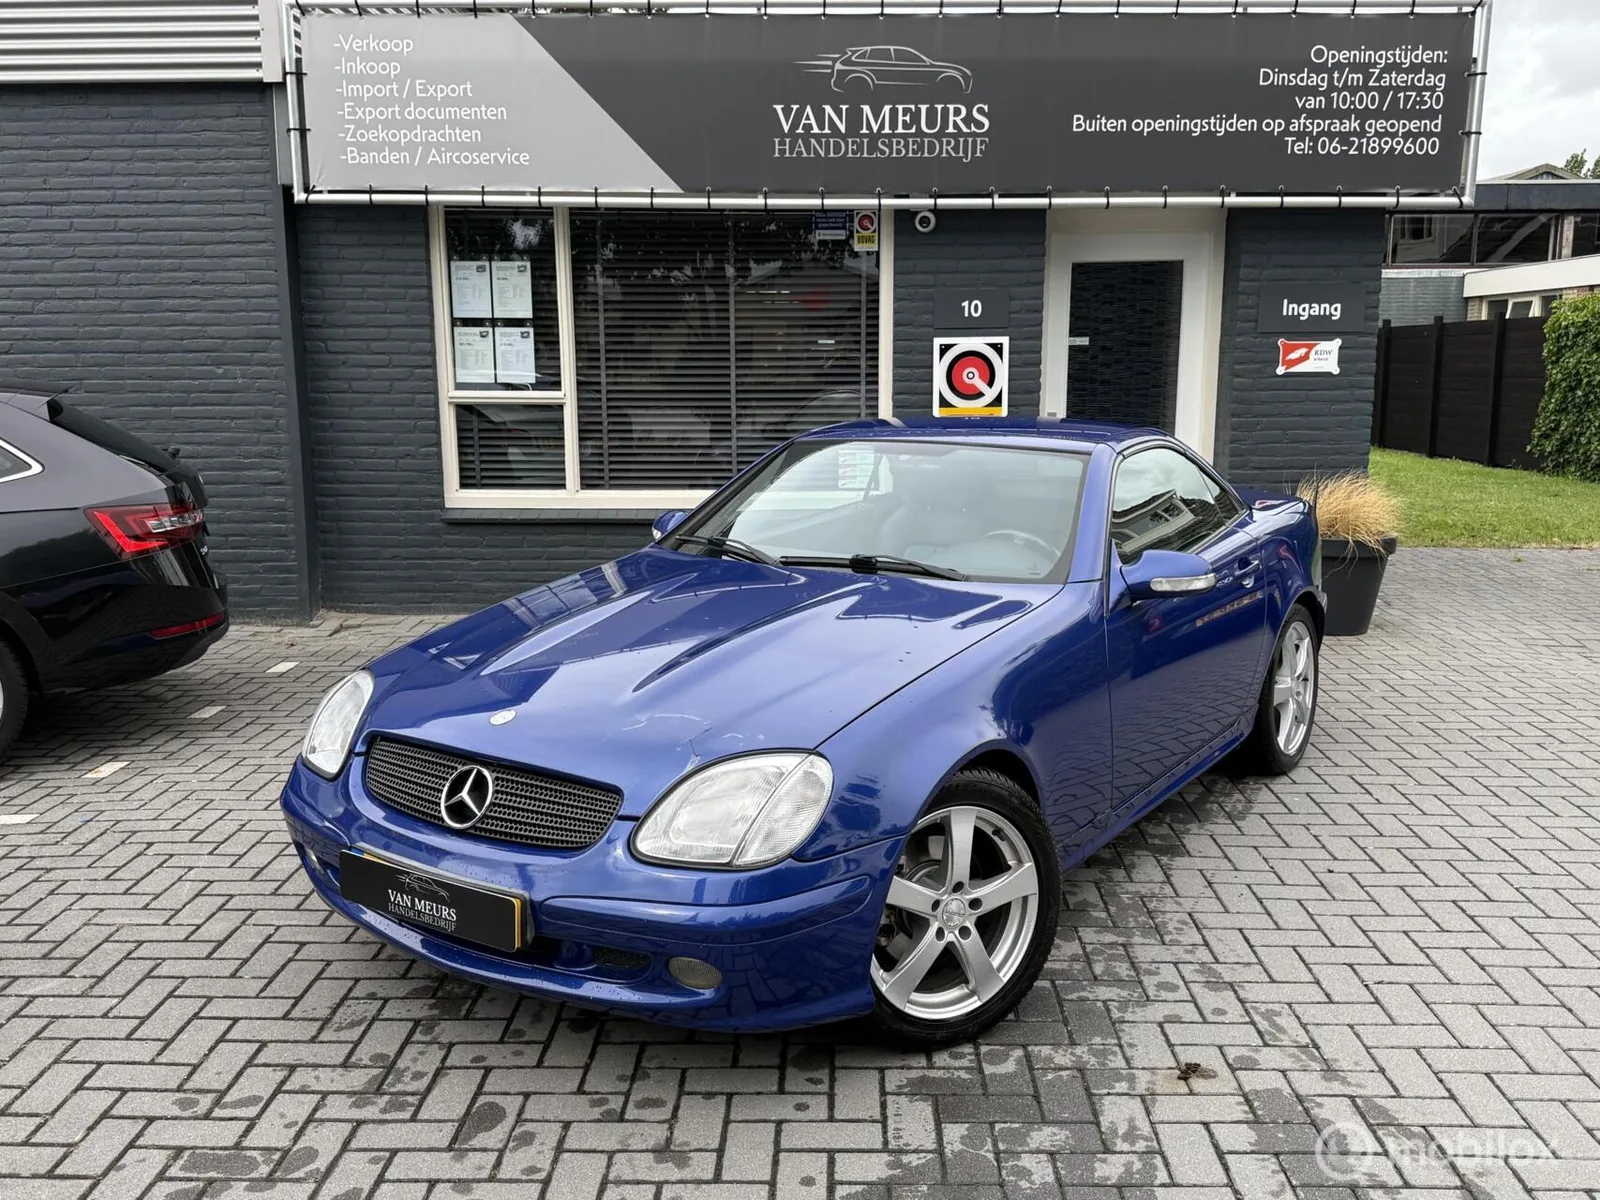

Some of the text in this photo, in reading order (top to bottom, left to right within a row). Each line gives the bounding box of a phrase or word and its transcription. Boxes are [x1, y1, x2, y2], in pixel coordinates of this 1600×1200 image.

[333, 33, 414, 56] -Verkoop
[1310, 44, 1448, 67] Openingstijden:
[334, 56, 401, 79] -Inkoop
[1258, 67, 1447, 91] Dinsdag t/m Zaterdag
[335, 79, 473, 102] -Import / Export
[1295, 91, 1444, 111] van 10:00 / 17:30
[337, 102, 507, 124] -Export documenten
[772, 103, 991, 134] VAN MEURS
[338, 124, 482, 147] -Zoekopdrachten
[1072, 114, 1443, 137] Buiten openingstijden op afspraak geopend
[340, 146, 530, 166] -Banden / Aircoservice
[772, 137, 990, 163] HANDELSBEDRIJF
[1284, 137, 1440, 155] Tel: 06-21899600
[961, 299, 983, 318] 10
[1282, 298, 1342, 321] Ingang
[388, 889, 457, 922] VAN MEURS
[388, 902, 457, 932] HANDELSBEDRIJF
